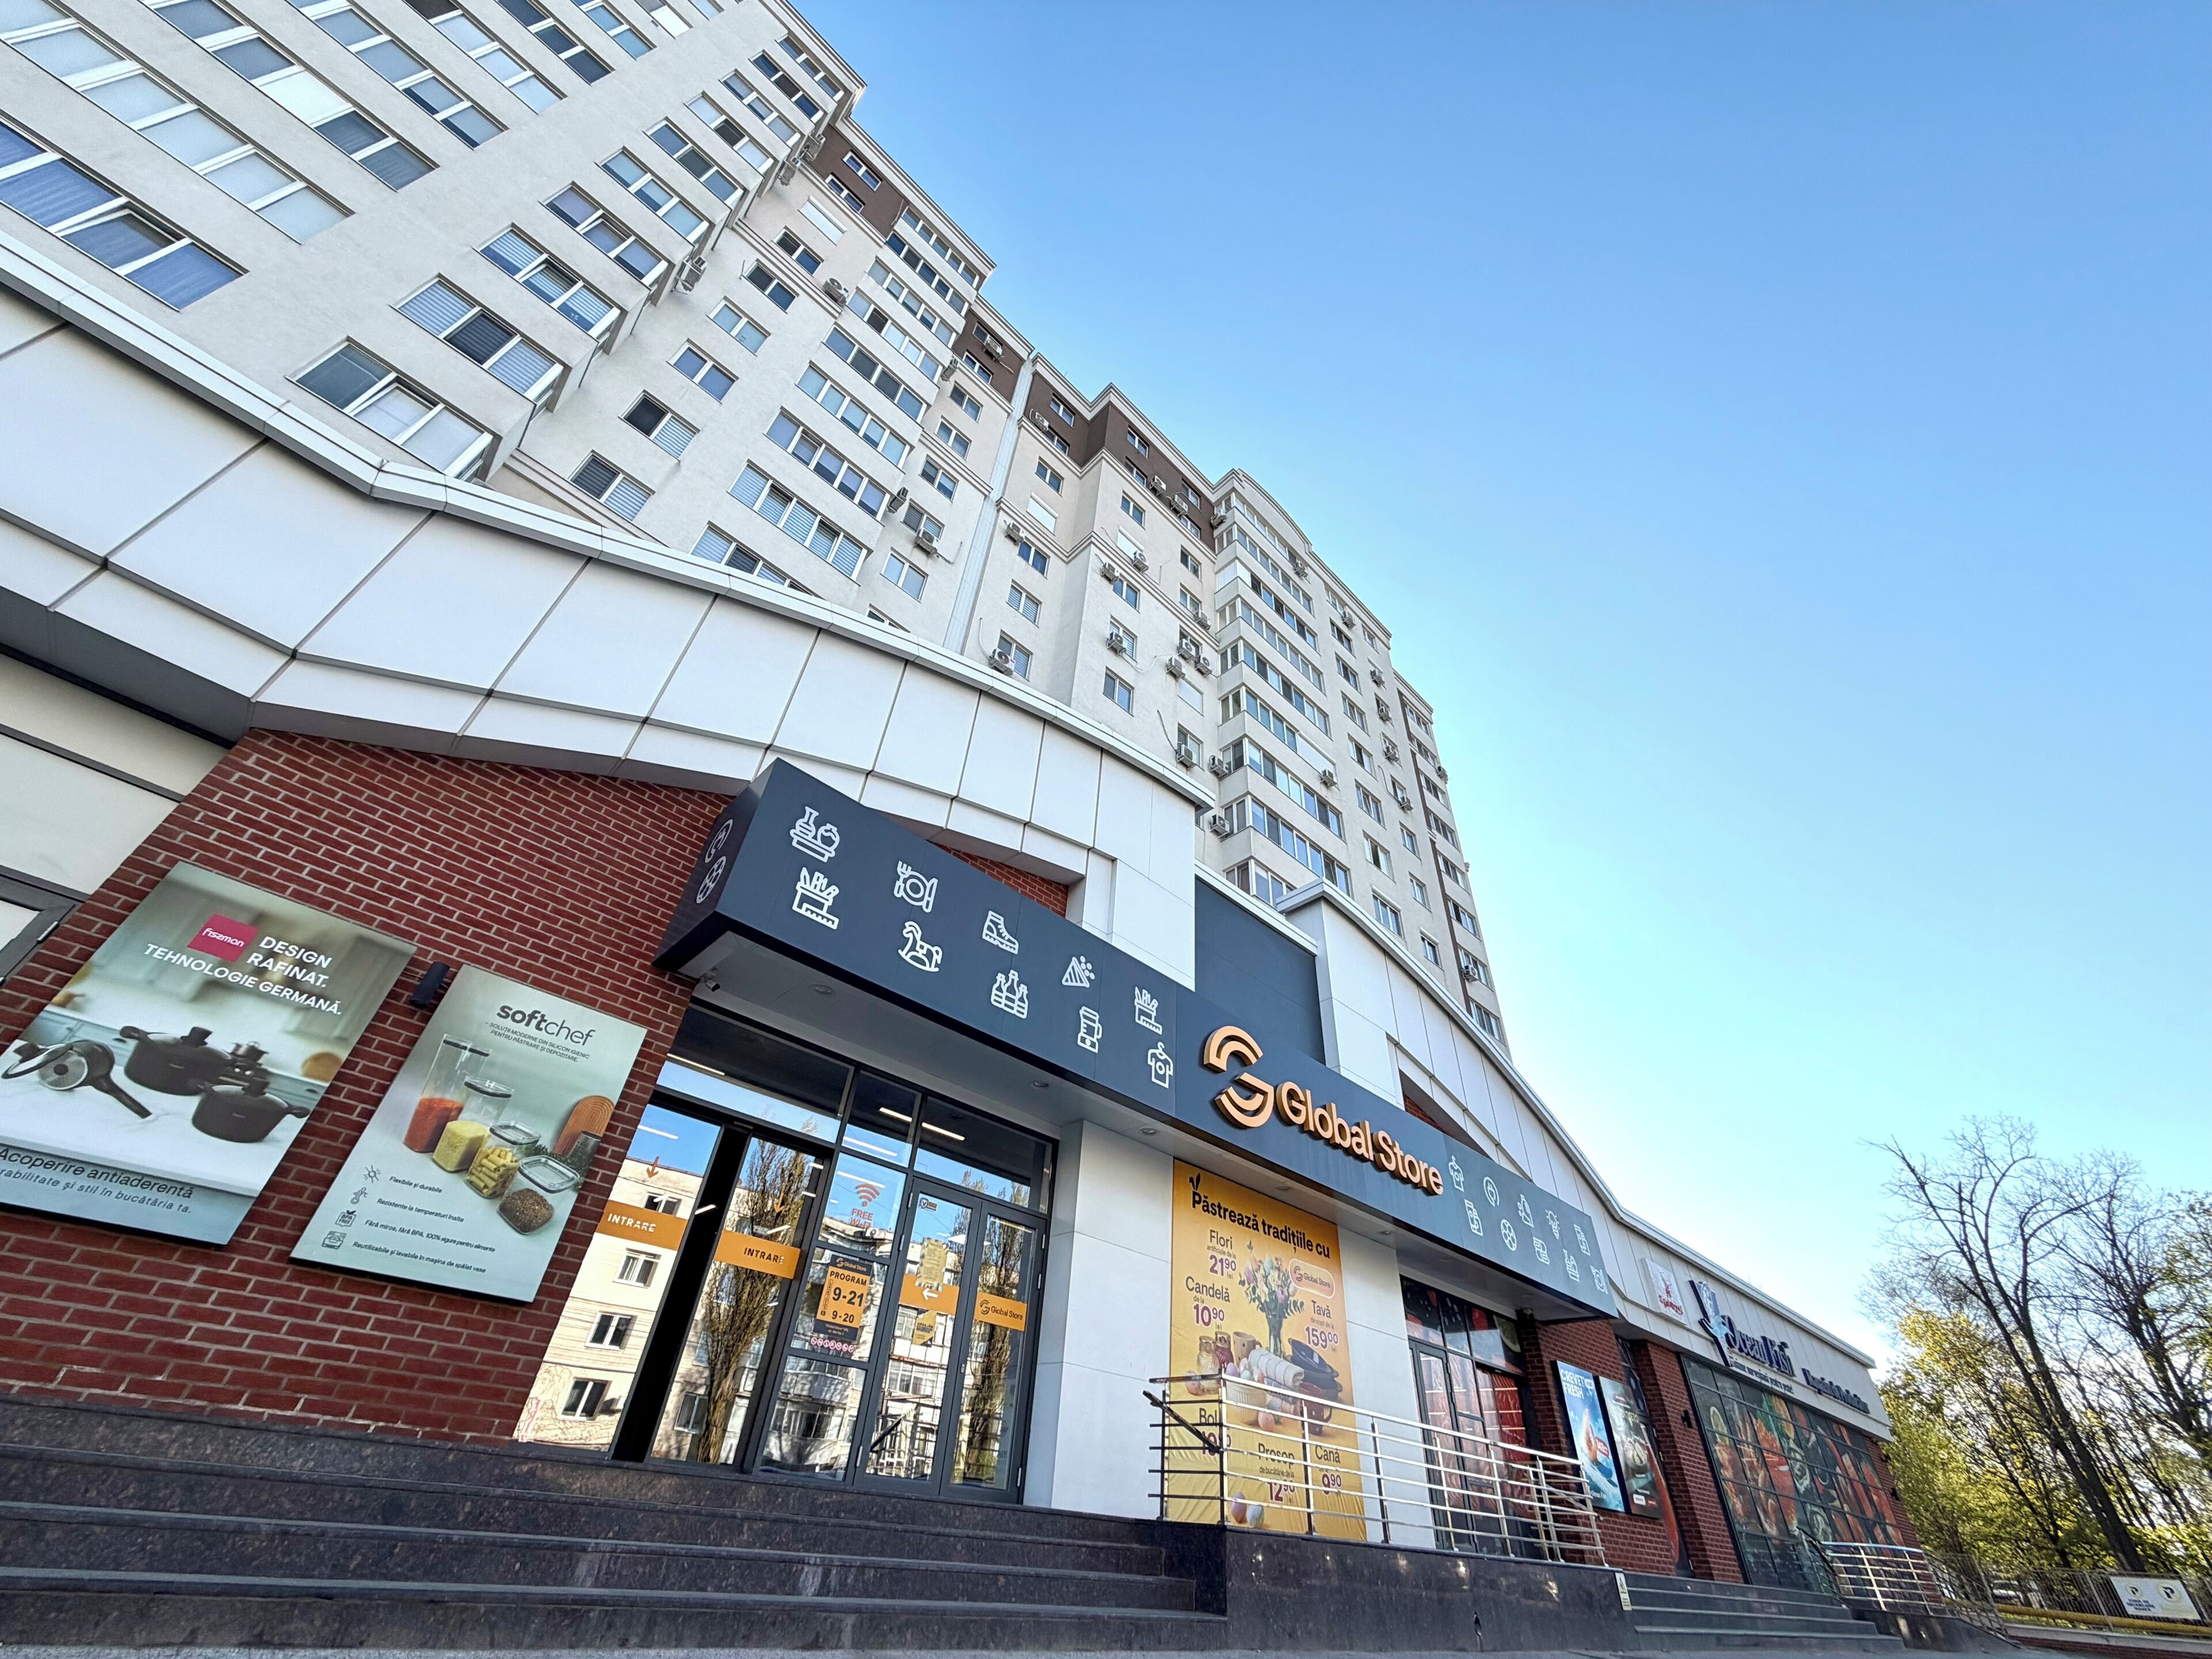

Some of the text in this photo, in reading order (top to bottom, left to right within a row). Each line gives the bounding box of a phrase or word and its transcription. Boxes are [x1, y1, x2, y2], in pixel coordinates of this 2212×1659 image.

[259, 935, 332, 968] DESIGN
[144, 944, 342, 1016] TEHNOLOGIE GERMANĂ.
[247, 952, 329, 988] RAFINAT.
[497, 1005, 596, 1046] softchef
[490, 1029, 513, 1040] PENTRU
[512, 1036, 540, 1050] PĂSTRARE
[511, 1029, 539, 1043] MODERNE
[548, 1041, 570, 1052] SILICON
[570, 1048, 590, 1059] IGIENIC
[1276, 1081, 1445, 1196] Global Store
[0, 1147, 194, 1199] Acoperire antiaderentă
[0, 1169, 60, 1187] rabilitate
[77, 1183, 99, 1195] stil
[100, 1187, 112, 1196] în
[115, 1190, 174, 1210] bucătăria
[177, 1203, 192, 1214] ta.
[389, 1176, 412, 1186] Flexibile
[419, 1183, 442, 1194] durabile
[377, 1198, 407, 1210] Rezistente
[414, 1206, 448, 1219] temperaturi
[851, 1208, 874, 1221] FREE
[608, 1213, 657, 1233] INTRARE
[1192, 1190, 1330, 1259] Păstrează tradițiile cu
[426, 1232, 441, 1241] 100%
[456, 1239, 474, 1248] pentru
[1210, 1229, 1233, 1250] Flori
[744, 1247, 785, 1264] INTRARE
[473, 1266, 486, 1274] vase
[830, 1270, 867, 1286] PROGRAM
[1303, 1272, 1331, 1289] Global Store
[1185, 1276, 1230, 1303] Candelă
[991, 1305, 1023, 1320] Global Store
[1311, 1300, 1332, 1319] Tavă
[1563, 1382, 1585, 1399] FRESH
[1199, 1407, 1217, 1427] Bol
[1258, 1442, 1295, 1469] Prosop
